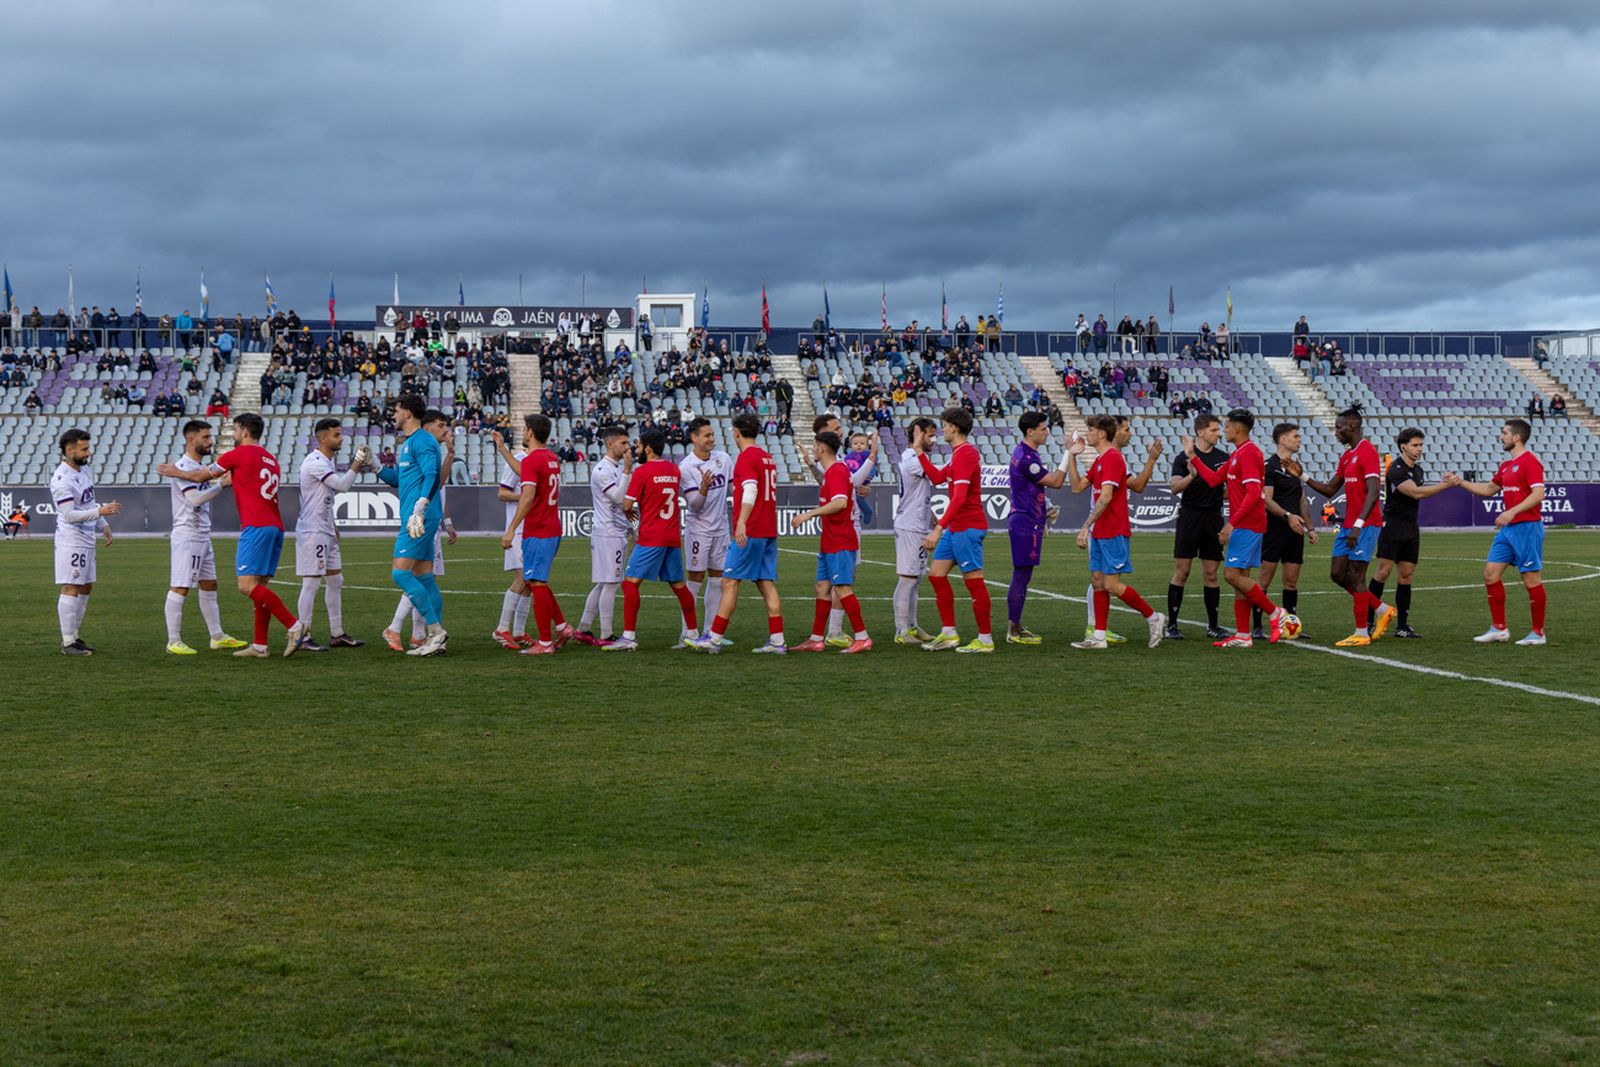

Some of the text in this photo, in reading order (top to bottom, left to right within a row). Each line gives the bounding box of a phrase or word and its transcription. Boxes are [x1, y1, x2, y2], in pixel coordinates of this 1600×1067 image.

[407, 308, 439, 323] JÉN
[521, 308, 554, 324] JAÉN
[981, 467, 995, 475] EAL
[548, 473, 560, 506] 2
[660, 487, 675, 520] 3
[692, 541, 699, 555] 8
[71, 553, 86, 568] 26
[191, 554, 200, 570] 11
